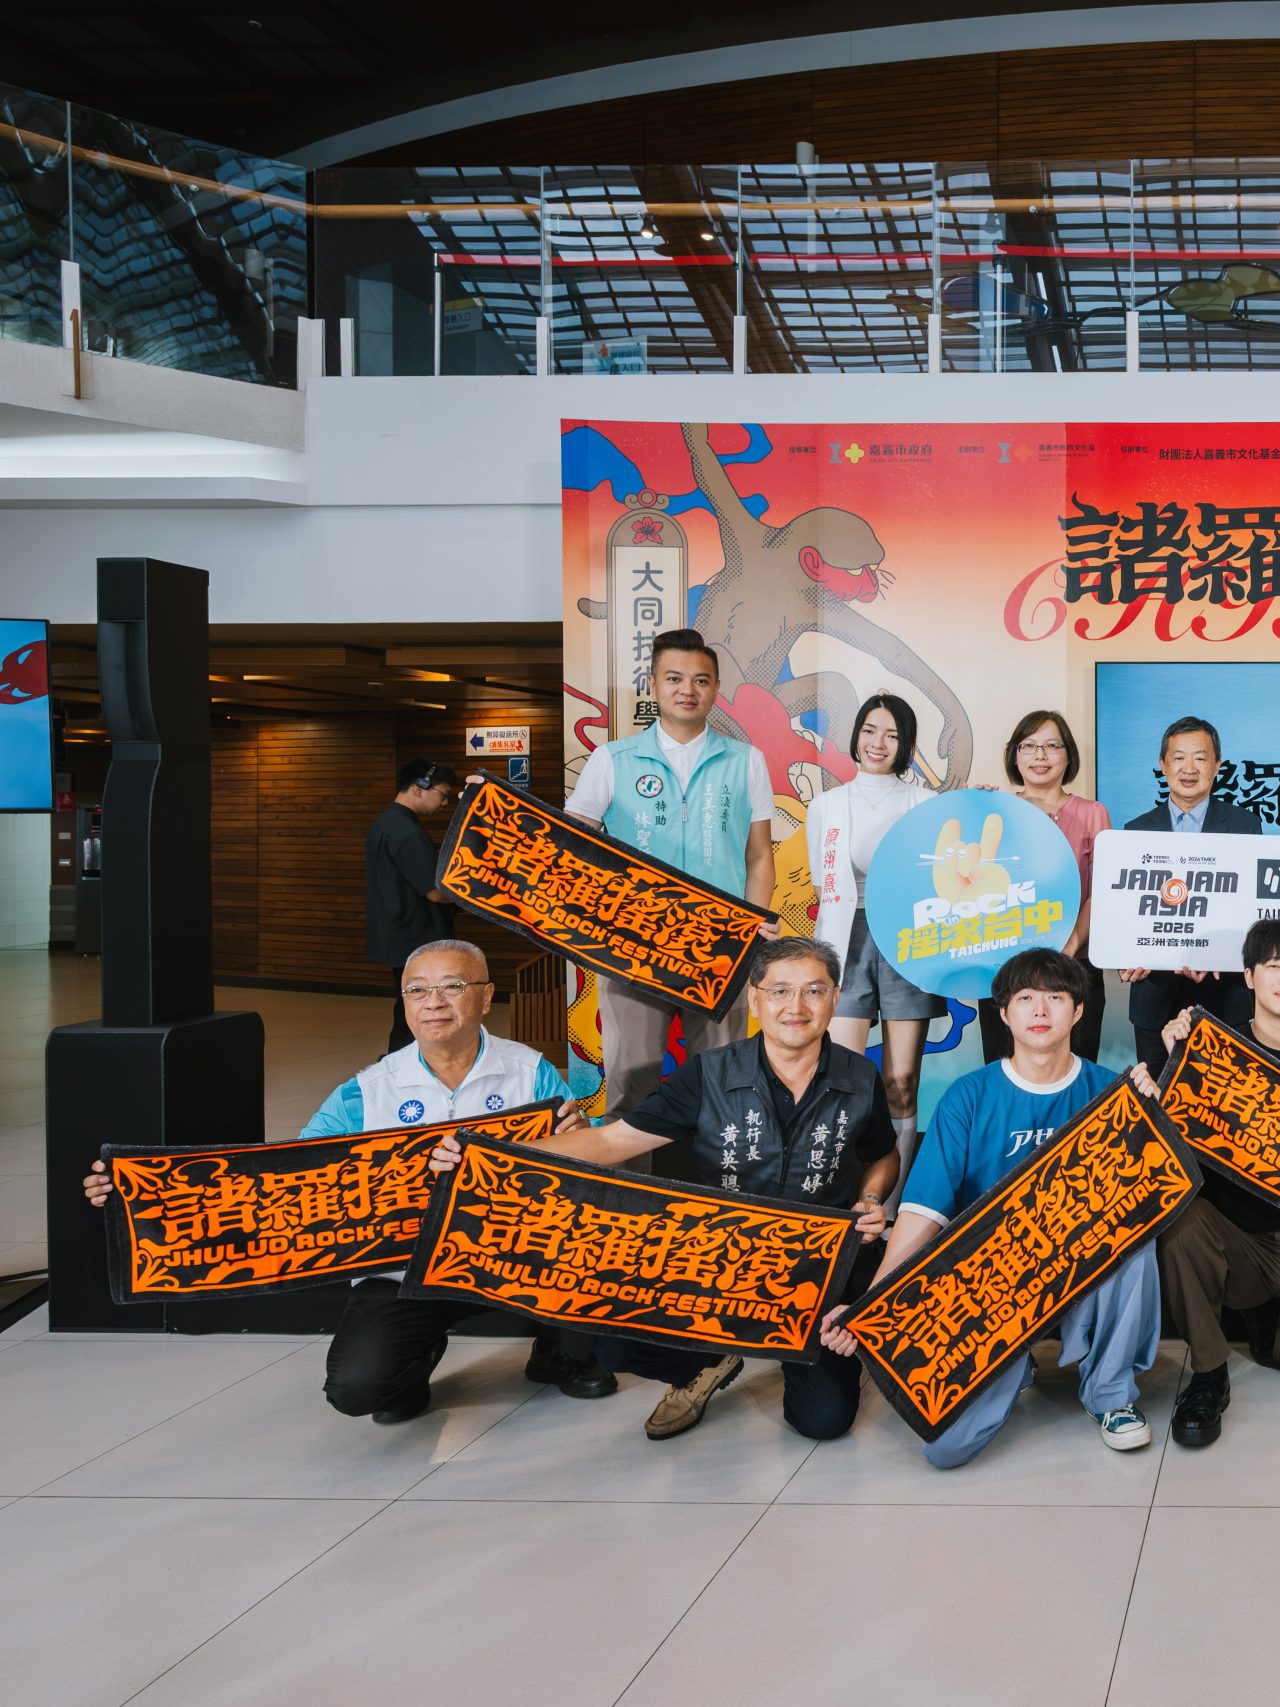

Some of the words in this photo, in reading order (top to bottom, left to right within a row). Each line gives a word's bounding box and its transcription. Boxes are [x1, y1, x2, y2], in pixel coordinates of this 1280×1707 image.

[869, 444, 933, 456] 嘉義市政府
[655, 800, 667, 826] 特助
[720, 784, 732, 832] 立法委員
[1111, 868, 1173, 891] JAM
[1184, 871, 1239, 894] JAM
[1138, 895, 1209, 917] ASIA
[470, 866, 549, 912] JHULUO
[553, 908, 608, 942] ROCK
[610, 932, 704, 980] FESTIVAL
[949, 936, 1018, 959] TAICHUNG
[1137, 937, 1209, 948] 亞洲音樂節
[1153, 922, 1194, 933] 2026
[745, 1109, 763, 1161] 執行長
[826, 1110, 848, 1184] 嘉義市議員
[1187, 1102, 1260, 1157] JHULUO
[720, 1123, 740, 1192] 黃英聰
[801, 1123, 831, 1194] 黃思婷
[159, 1157, 431, 1243] 諸羅搖
[166, 1236, 287, 1267] JHULUO
[299, 1223, 370, 1250] ROCK
[470, 1251, 576, 1289] JHULUO
[583, 1278, 655, 1306] ROCK
[664, 1289, 786, 1324] FESTIVAL
[937, 1299, 1019, 1378] JHULUO
[1019, 1256, 1068, 1304] ROCK
[1071, 1178, 1161, 1263] FESTIVAL
